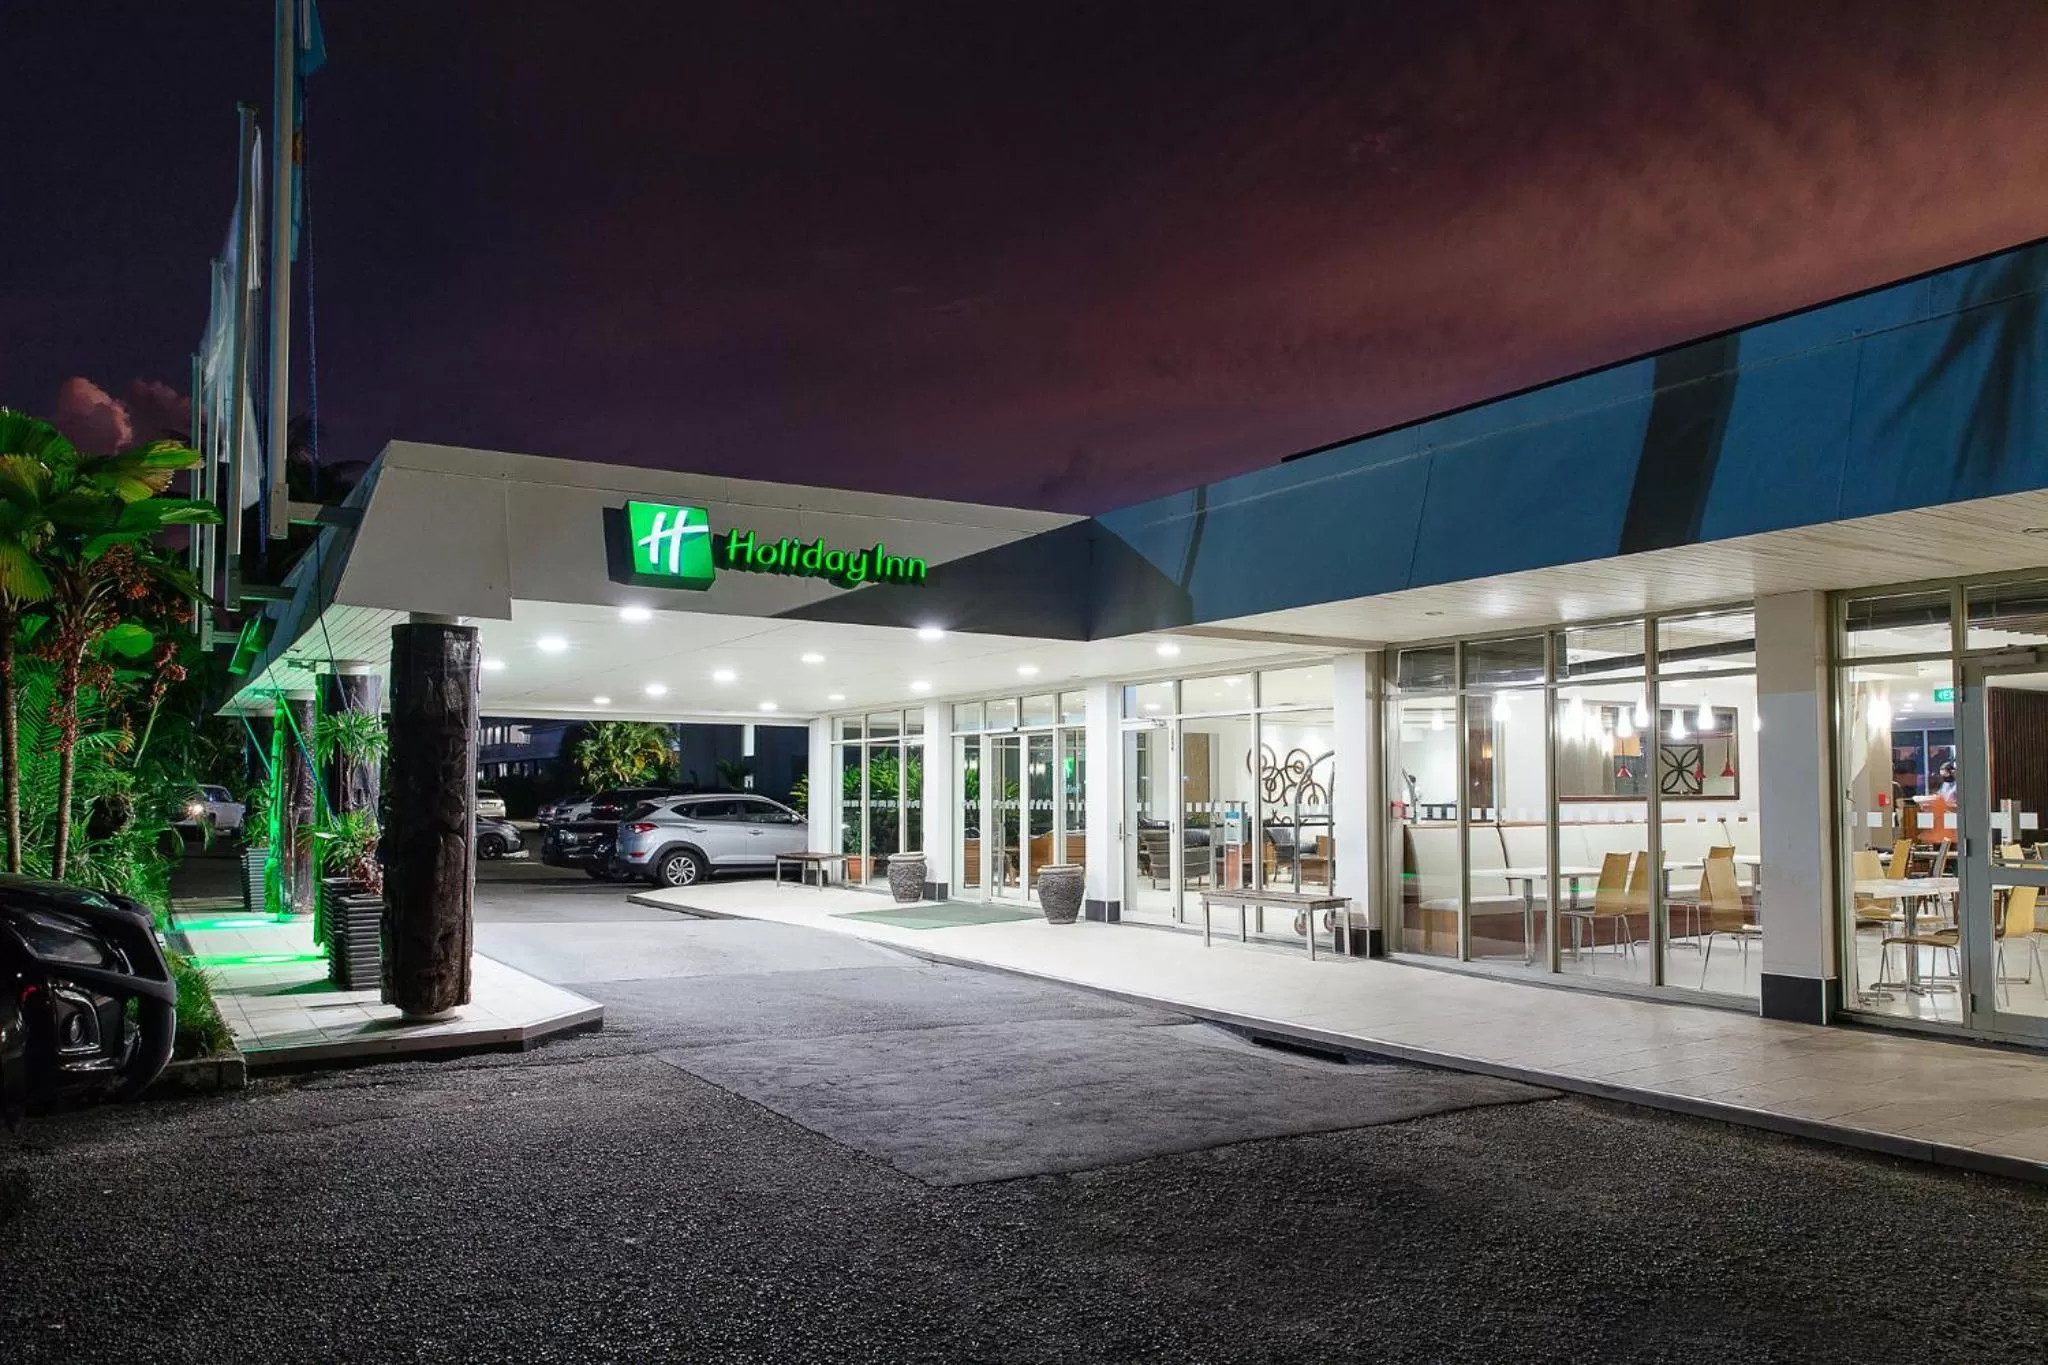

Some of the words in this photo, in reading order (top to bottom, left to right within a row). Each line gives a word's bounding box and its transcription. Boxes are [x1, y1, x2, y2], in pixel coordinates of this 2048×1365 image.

[638, 510, 709, 574] H
[726, 528, 868, 581] Holiday
[875, 542, 927, 578] Inn
